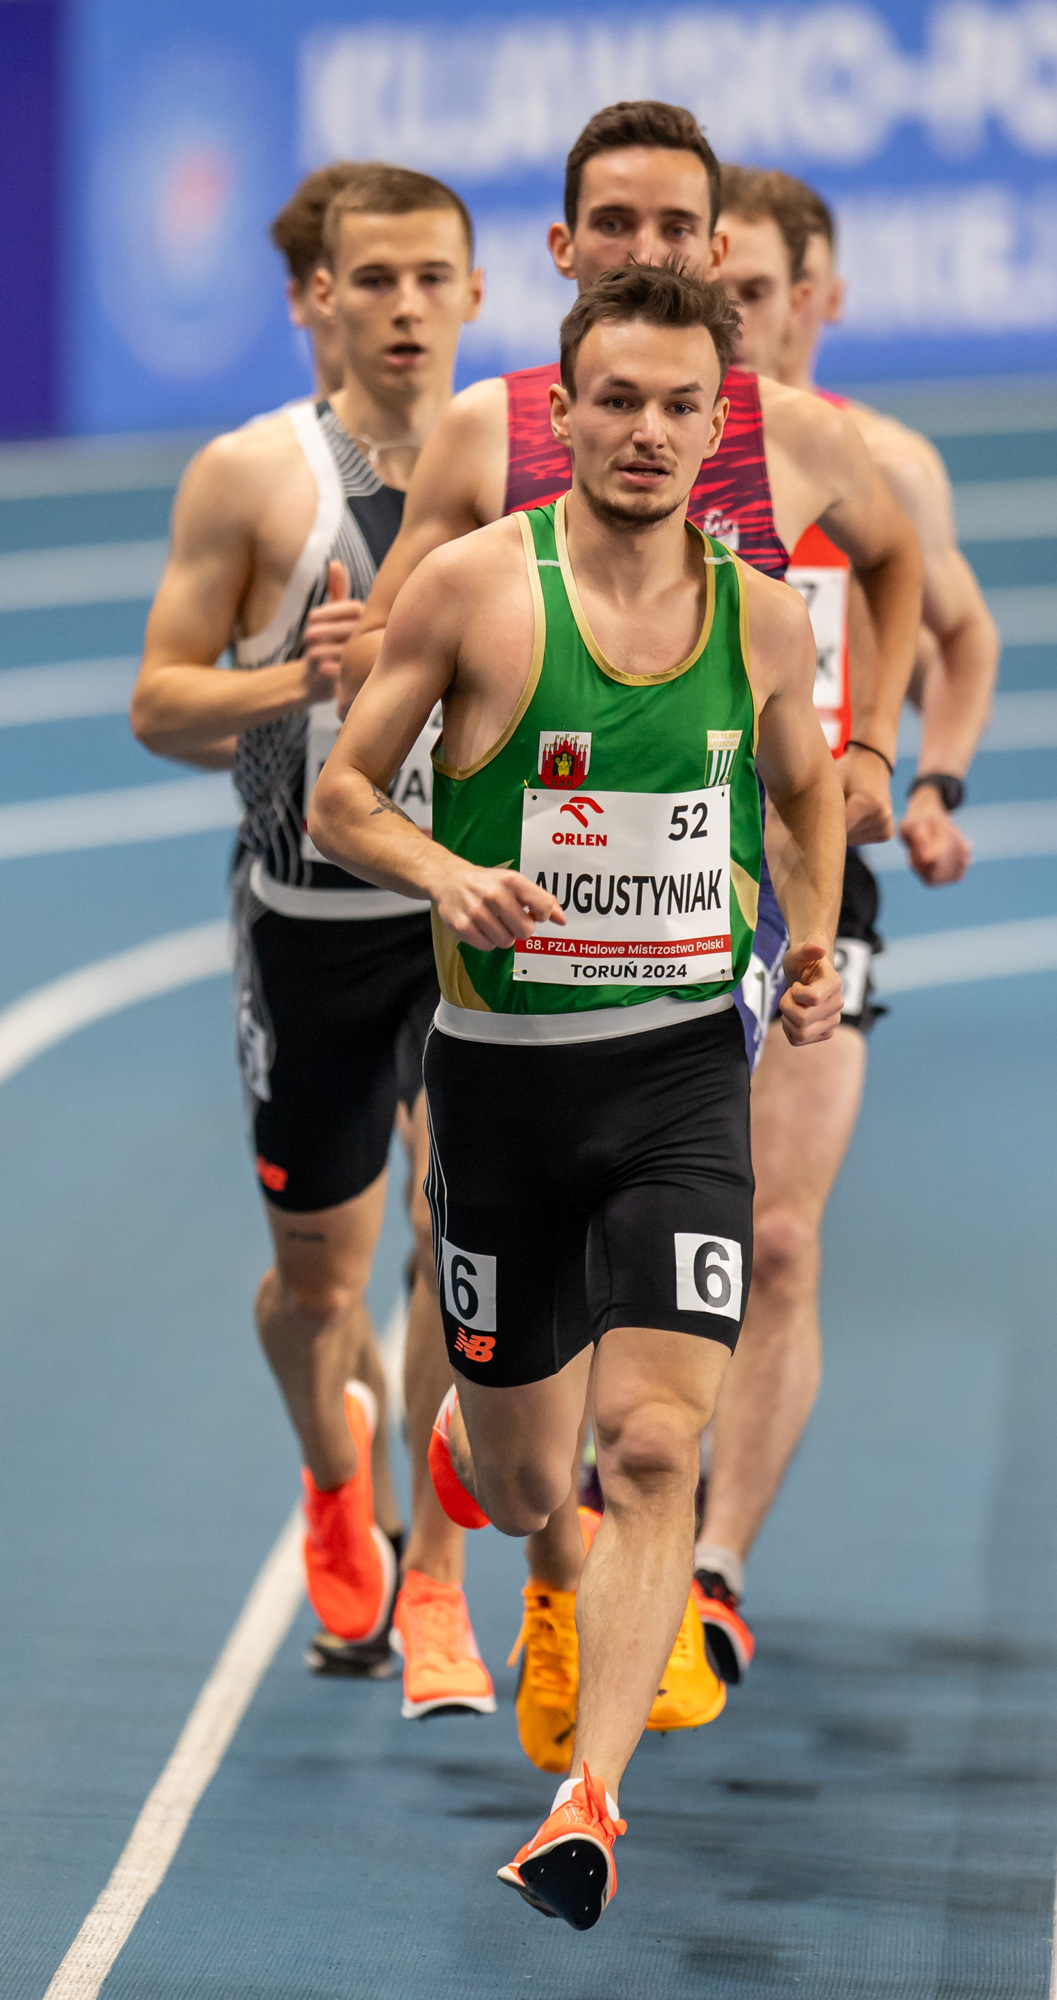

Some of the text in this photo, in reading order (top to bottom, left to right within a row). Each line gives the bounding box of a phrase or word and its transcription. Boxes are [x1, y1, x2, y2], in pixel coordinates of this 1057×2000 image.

[668, 802, 709, 842] 52
[551, 832, 608, 847] ORLEN
[525, 937, 724, 955] 68. PZLA Halowe Mistrzostwa Polski
[570, 960, 687, 979] TORUŃ 2024
[451, 1254, 479, 1321] 6
[694, 1241, 732, 1309] 6
